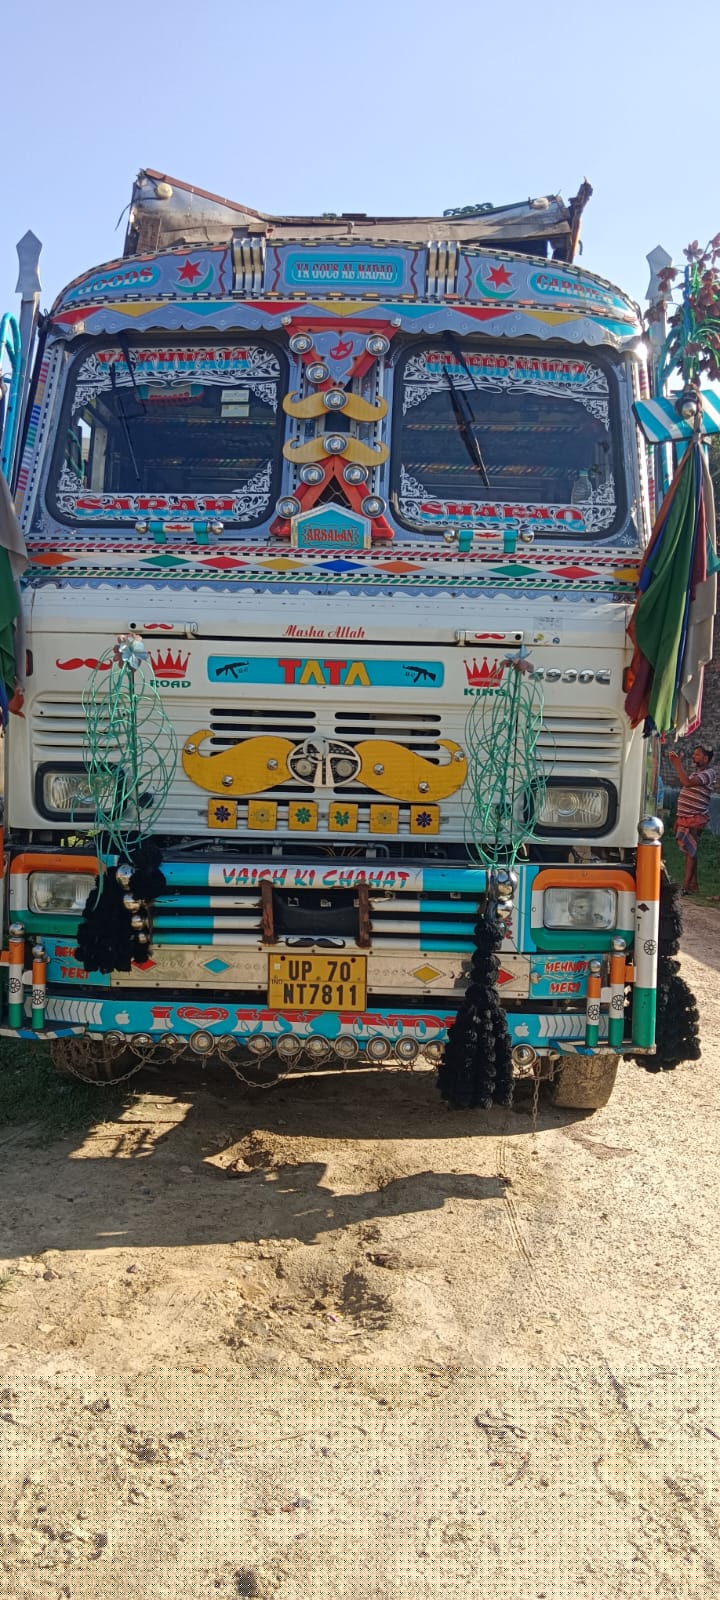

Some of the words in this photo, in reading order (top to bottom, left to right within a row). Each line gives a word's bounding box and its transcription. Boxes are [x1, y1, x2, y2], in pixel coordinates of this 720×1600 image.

[297, 264, 309, 279] YA
[357, 264, 394, 281] MADAD
[537, 275, 612, 304] CARRIER
[515, 359, 586, 383] NAWAZ
[307, 528, 354, 542] ARSALAN
[283, 625, 325, 638] Masha
[327, 626, 366, 639] Allah
[278, 660, 371, 686] TATA
[150, 680, 192, 689] ROAD
[464, 688, 507, 697] KING
[295, 869, 317, 887] KI
[322, 869, 410, 889] CHAHAT
[288, 960, 313, 981] UP
[327, 961, 352, 982] 70
[283, 983, 357, 1006] NT7811
[550, 982, 580, 993] MERI
[152, 1006, 175, 1030] I
